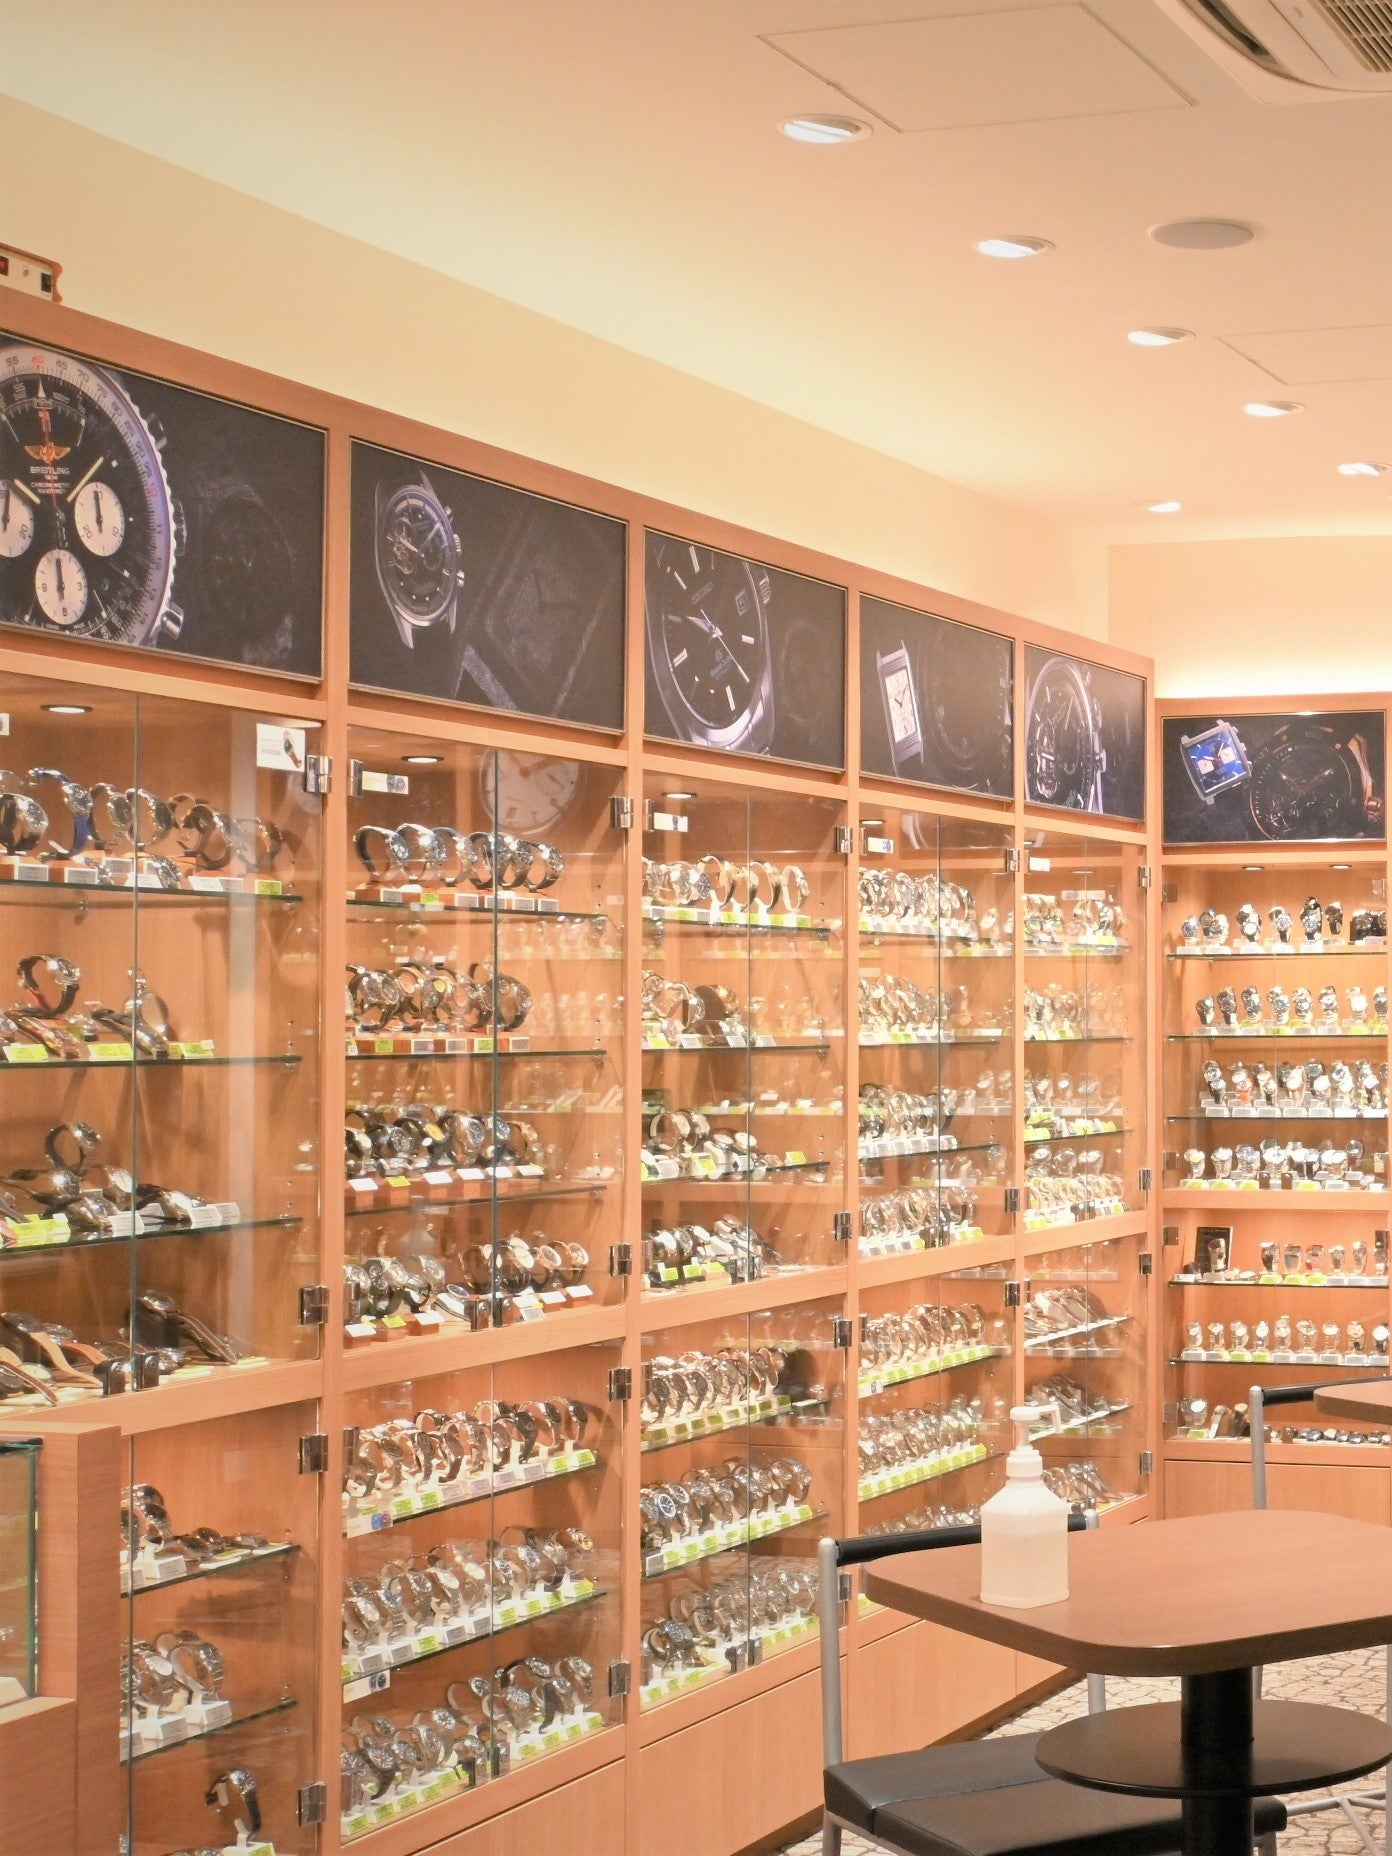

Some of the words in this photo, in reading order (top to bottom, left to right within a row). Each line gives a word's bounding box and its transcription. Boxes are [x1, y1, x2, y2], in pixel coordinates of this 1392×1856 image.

[6, 356, 19, 366] 55
[30, 466, 70, 475] BREITLING
[82, 525, 93, 540] 20
[112, 526, 120, 538] 10
[41, 582, 48, 592] 9
[77, 581, 83, 592] 3
[62, 606, 68, 617] 6
